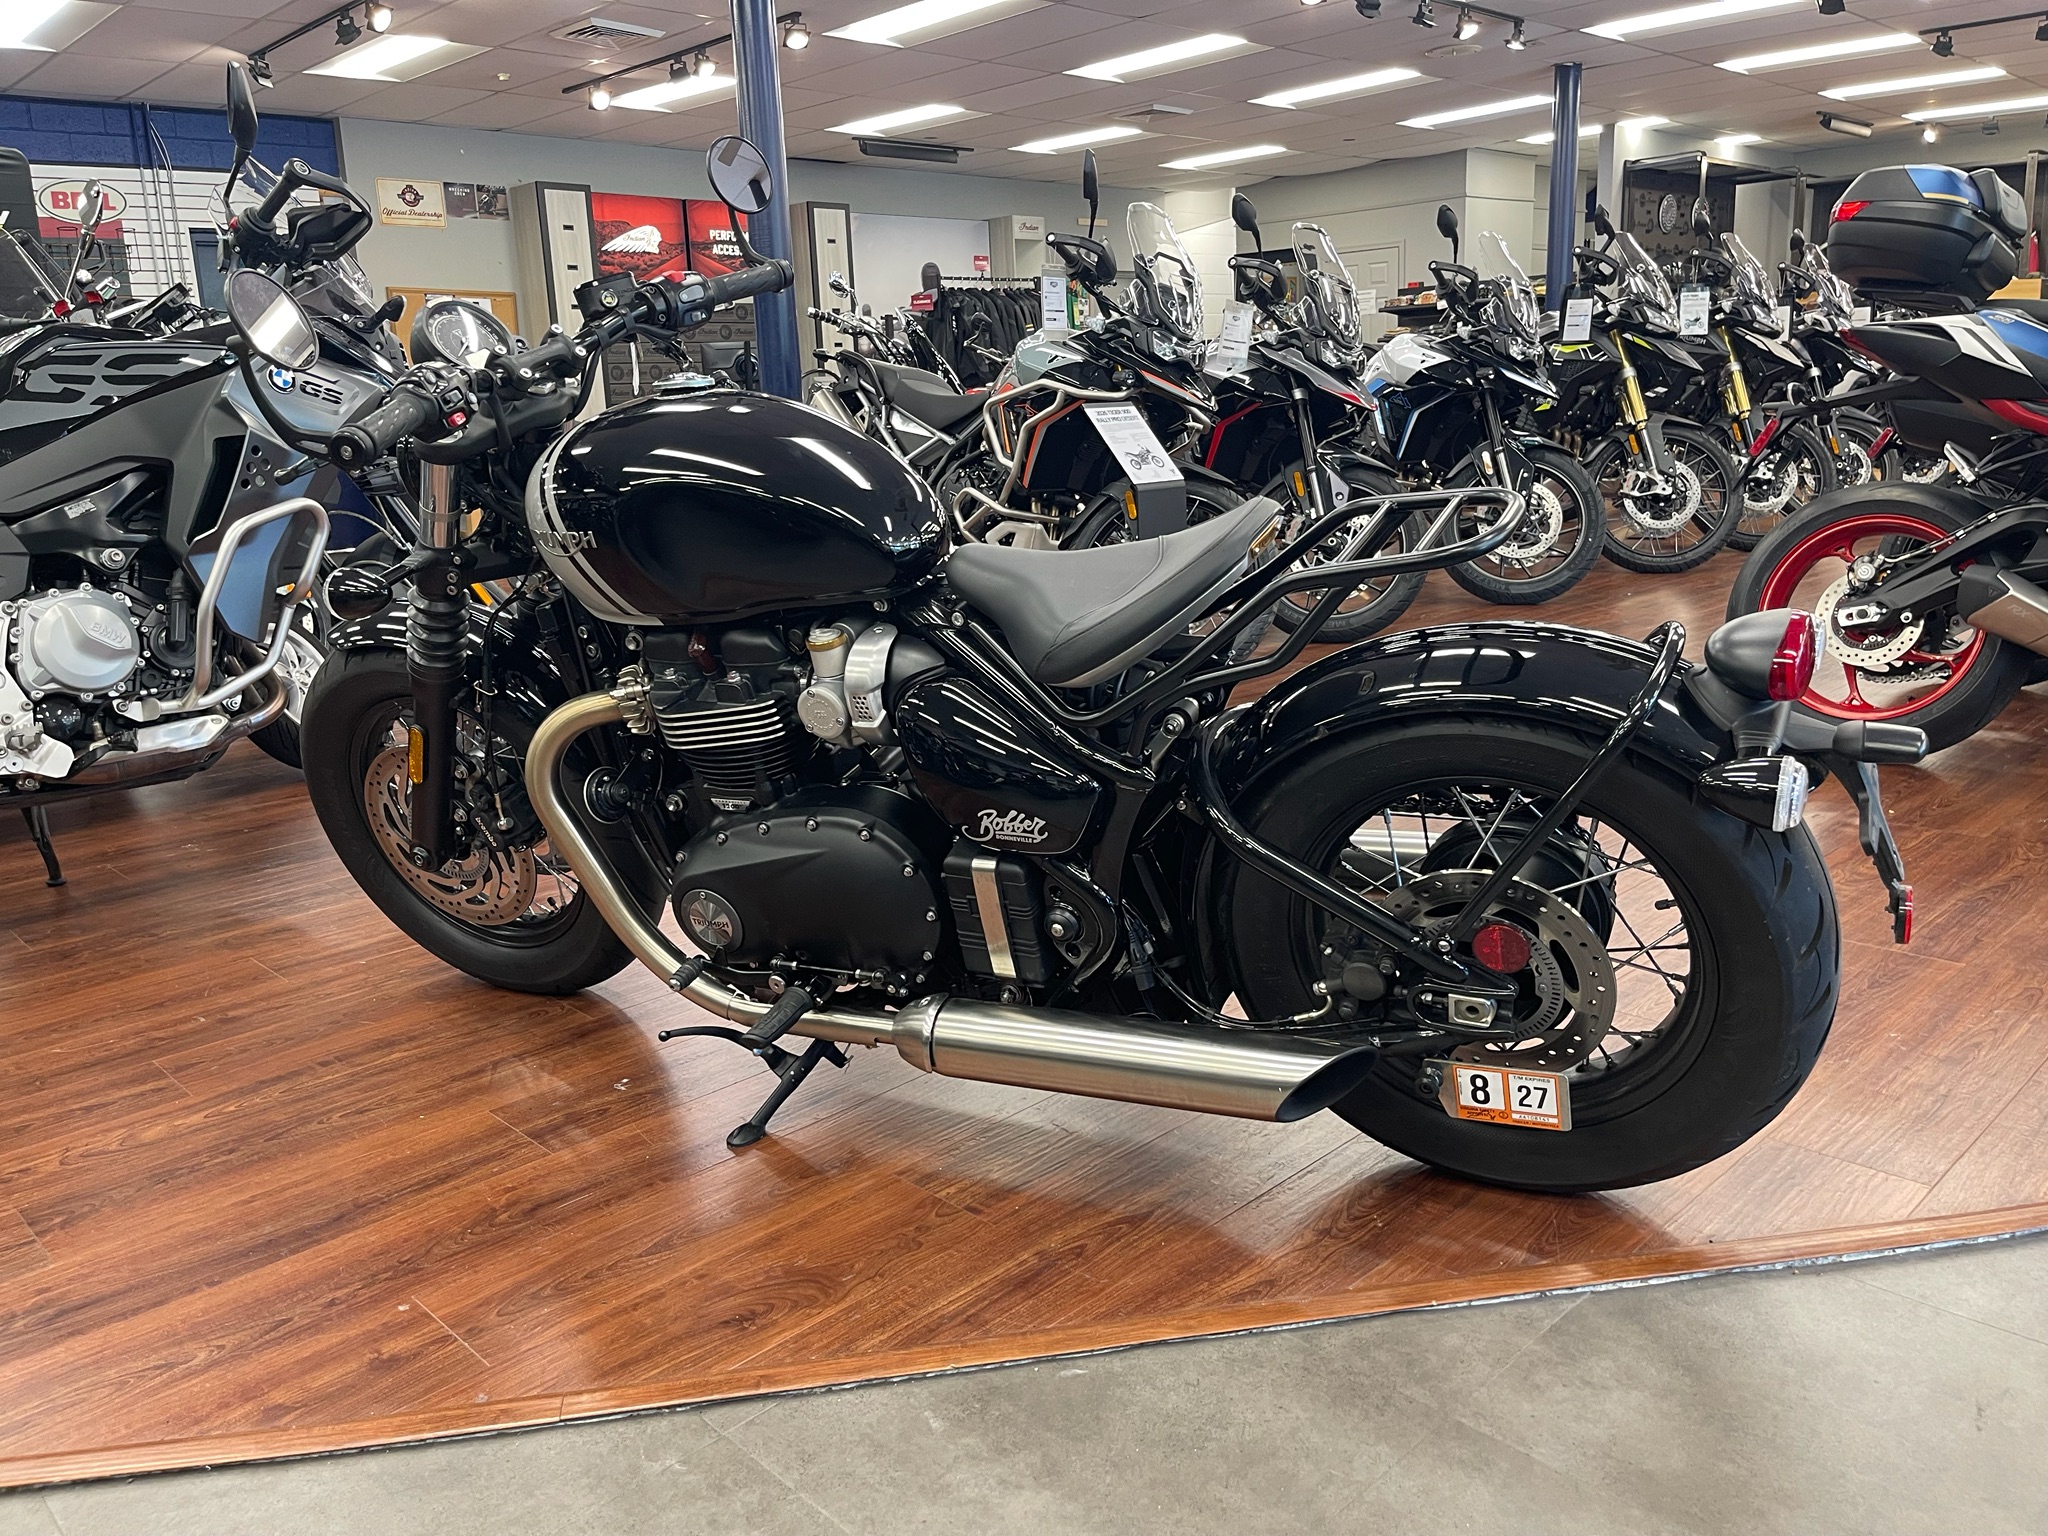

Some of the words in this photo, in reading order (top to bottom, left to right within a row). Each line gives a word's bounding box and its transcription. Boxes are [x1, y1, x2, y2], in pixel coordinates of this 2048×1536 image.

[382, 207, 407, 217] Official
[408, 209, 443, 219] Dealership
[1018, 222, 1039, 231] Indian
[300, 380, 344, 405] GS
[90, 622, 127, 644] BMW
[475, 816, 497, 847] brembo
[962, 809, 1049, 843] Bobber
[995, 834, 1033, 844] BONNEVILLE
[691, 917, 730, 930] TRIUMPH
[1469, 1073, 1491, 1105] 8
[1517, 1084, 1548, 1109] 27
